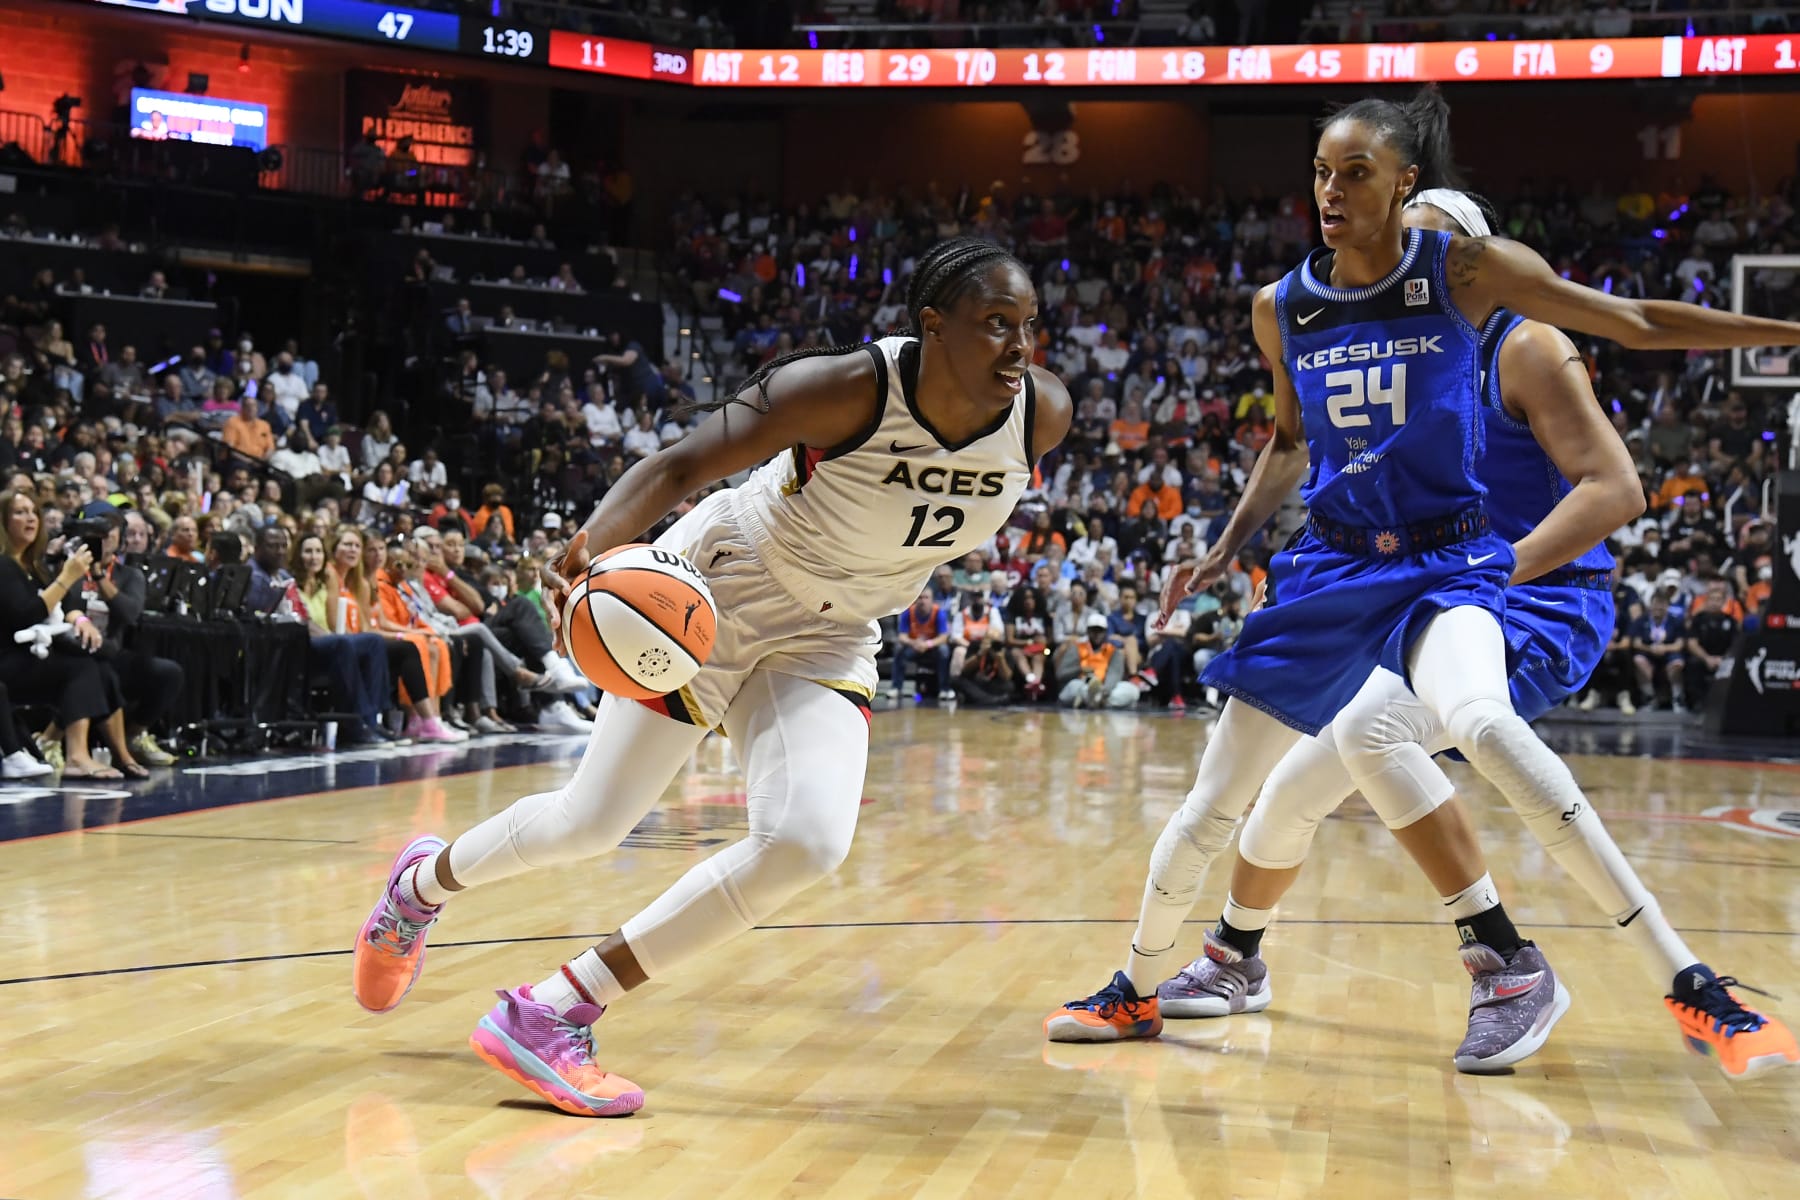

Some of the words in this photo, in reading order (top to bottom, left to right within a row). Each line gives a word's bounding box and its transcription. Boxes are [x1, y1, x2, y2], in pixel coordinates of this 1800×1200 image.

[377, 12, 414, 39] 47
[483, 27, 534, 57] 1:39
[581, 40, 606, 67] 11
[653, 52, 687, 75] 3RD
[701, 53, 742, 82] AST
[758, 55, 799, 81] 12
[822, 53, 864, 82] REB
[888, 55, 930, 81] 29
[956, 51, 996, 85] T/O
[1023, 54, 1065, 80] 12
[1162, 53, 1205, 79] 18
[1295, 50, 1341, 78] 45
[1455, 48, 1478, 75] 6
[1513, 45, 1556, 75] FTA
[1590, 44, 1613, 72] 9
[1697, 38, 1747, 72] AST
[1022, 130, 1079, 164] 28
[1297, 335, 1444, 372] KEESUSK
[1325, 363, 1406, 429] 24
[1344, 437, 1367, 450] Yale
[881, 460, 1007, 498] ACES
[901, 503, 965, 547] 12
